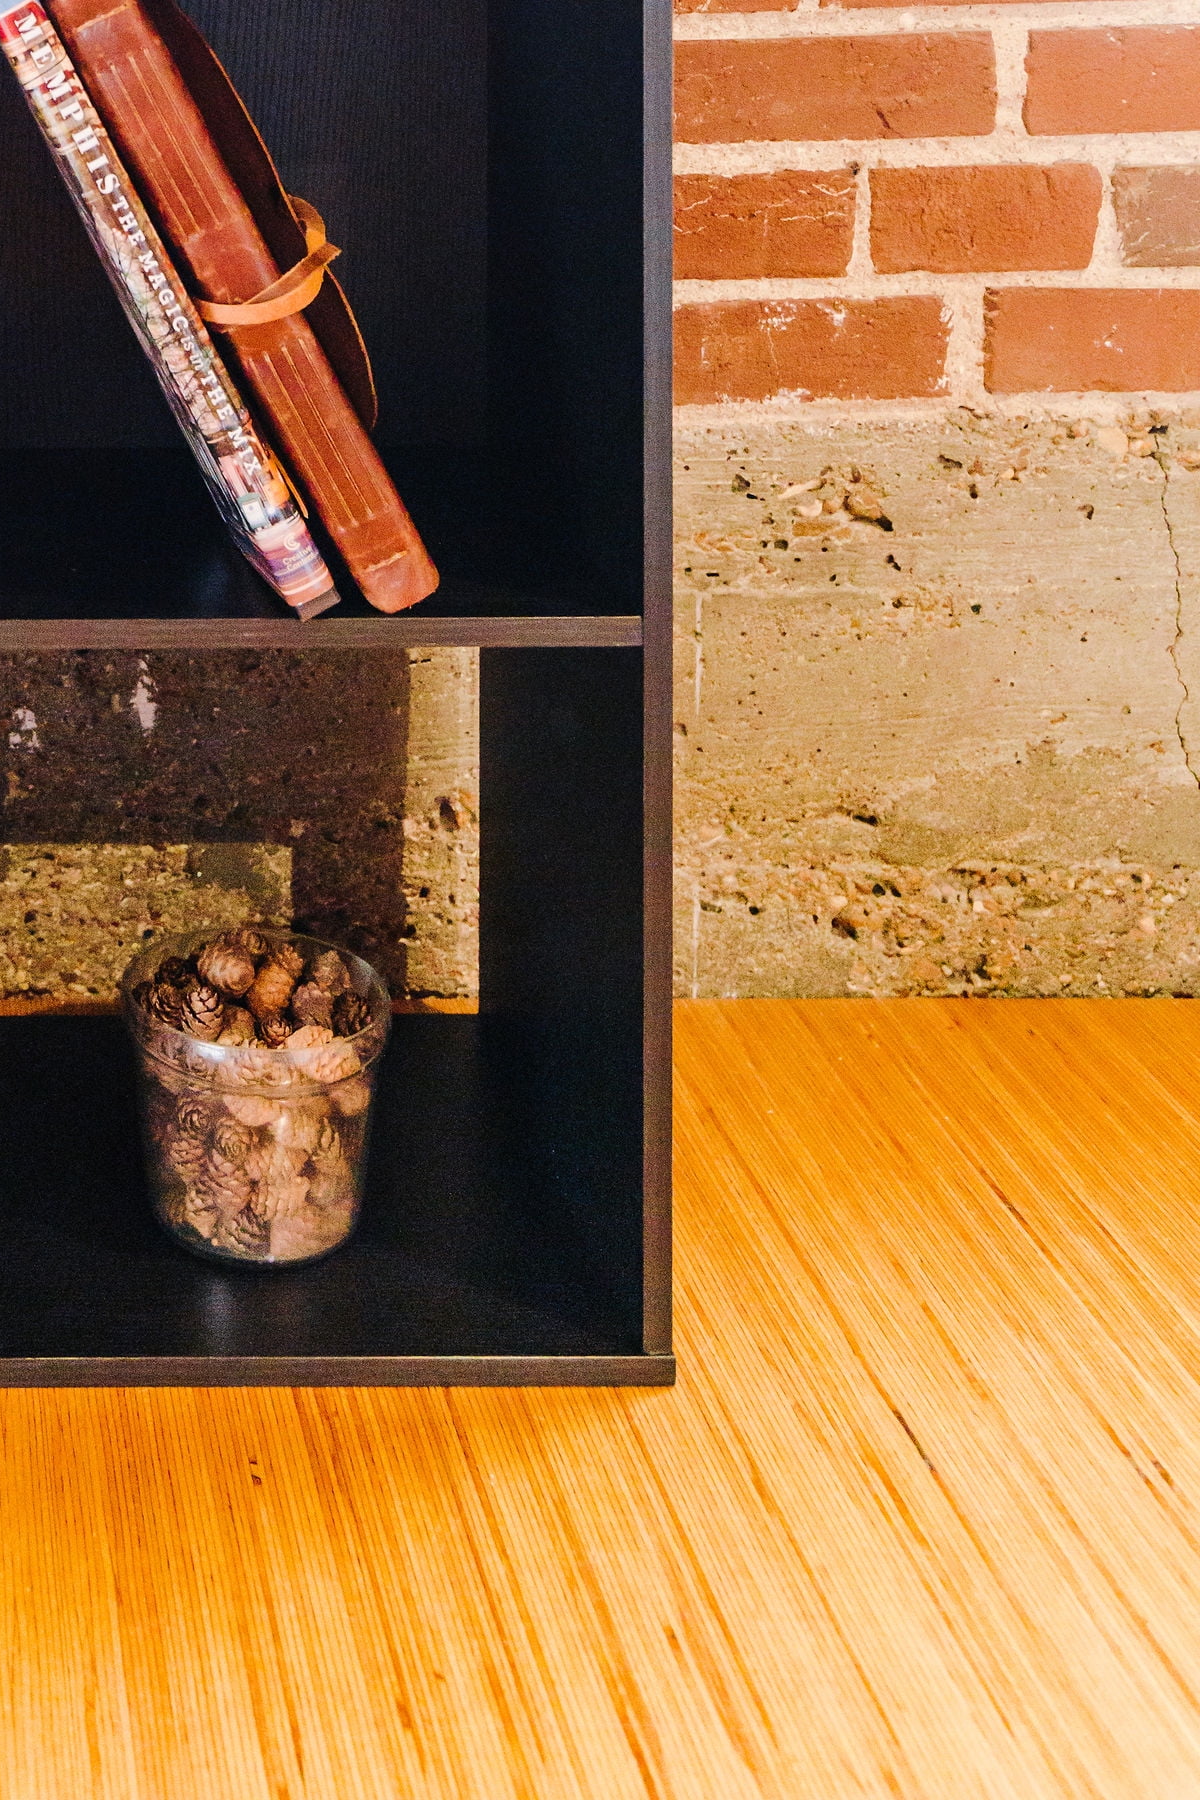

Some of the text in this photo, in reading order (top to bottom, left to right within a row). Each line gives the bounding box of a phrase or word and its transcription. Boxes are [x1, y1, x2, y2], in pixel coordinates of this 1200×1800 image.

[14, 11, 120, 195] MEMPHIS
[111, 194, 146, 247] THE
[138, 249, 188, 333] MAGIC
[180, 335, 195, 352] is
[201, 369, 234, 421] THE
[227, 426, 262, 481] MIX
